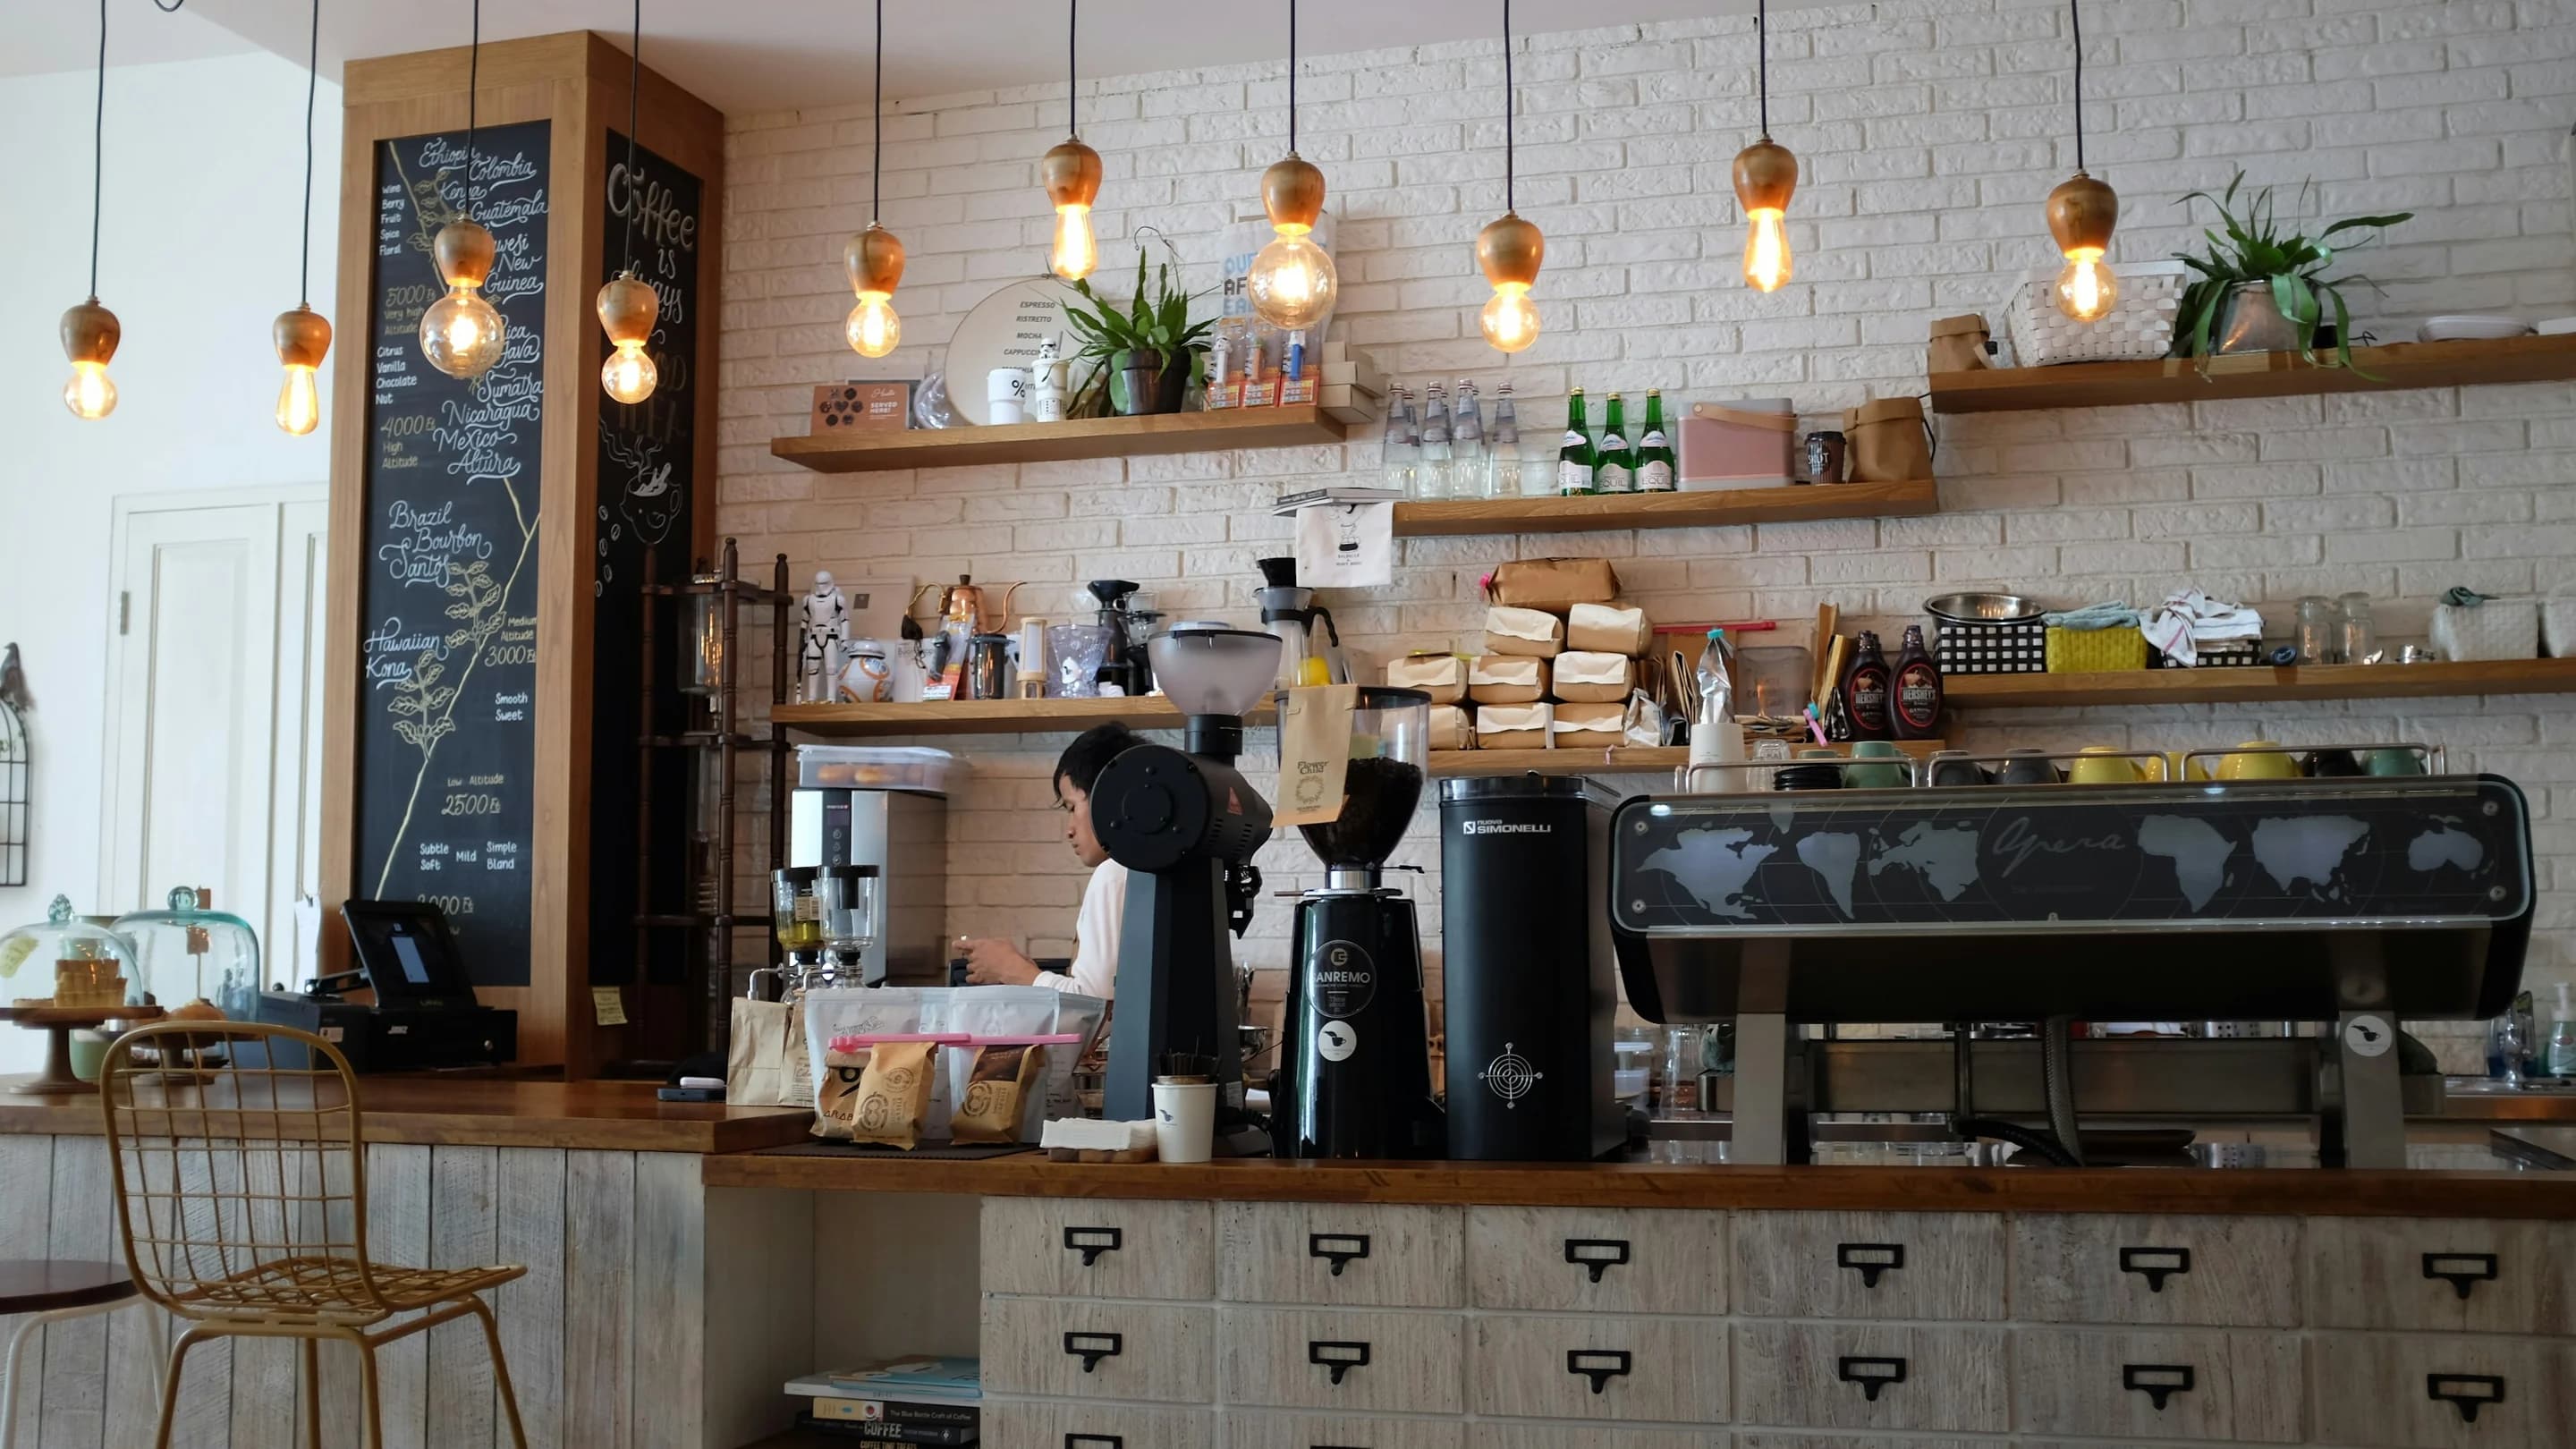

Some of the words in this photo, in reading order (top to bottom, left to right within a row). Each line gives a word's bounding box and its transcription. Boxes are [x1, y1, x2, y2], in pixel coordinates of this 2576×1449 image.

[469, 152, 537, 187] Colombia
[382, 184, 402, 194] Wine
[440, 181, 487, 209] Kenya
[382, 199, 405, 209] Berry
[471, 189, 549, 225] Guatemala
[608, 164, 694, 250] Coffee
[381, 214, 402, 224] Fruit
[379, 229, 400, 242] Spice
[379, 245, 402, 256] Floral
[497, 253, 542, 272] New
[658, 249, 676, 280] is
[485, 272, 544, 297] Guinea
[386, 284, 425, 308] 5000
[377, 346, 403, 358] Citrus
[492, 335, 540, 369] Java
[377, 361, 406, 374] Vanilla
[376, 375, 418, 389] Chocolate
[477, 369, 544, 405] Sumatra
[375, 394, 394, 405] Nut
[442, 400, 540, 431] Nicaragua
[380, 415, 425, 436] 4000
[433, 428, 518, 452] Mexico
[383, 442, 402, 455] High
[382, 456, 419, 469] Altitude
[447, 448, 521, 479] Altura
[389, 500, 453, 531] Brazil
[412, 524, 492, 559] Bourbon
[379, 538, 449, 588] Santos
[508, 616, 537, 626] Medium
[364, 617, 449, 661] Hawaiian
[501, 630, 534, 641] Altitude
[485, 645, 526, 666] 3000
[366, 654, 412, 684] Kona
[495, 691, 528, 705] Smooth
[496, 708, 522, 722] Sweet
[447, 777, 462, 787] Low
[470, 773, 504, 785] Altitude
[442, 794, 487, 816] 2500
[1477, 824, 1551, 835] SIMONELLI
[420, 843, 449, 856] Subtle
[487, 842, 517, 855] Simple
[1992, 816, 2126, 878] Opera
[456, 851, 477, 862] Mild
[487, 859, 514, 870] Bland
[420, 860, 442, 871] Soft
[864, 1422, 902, 1438] COFFEE
